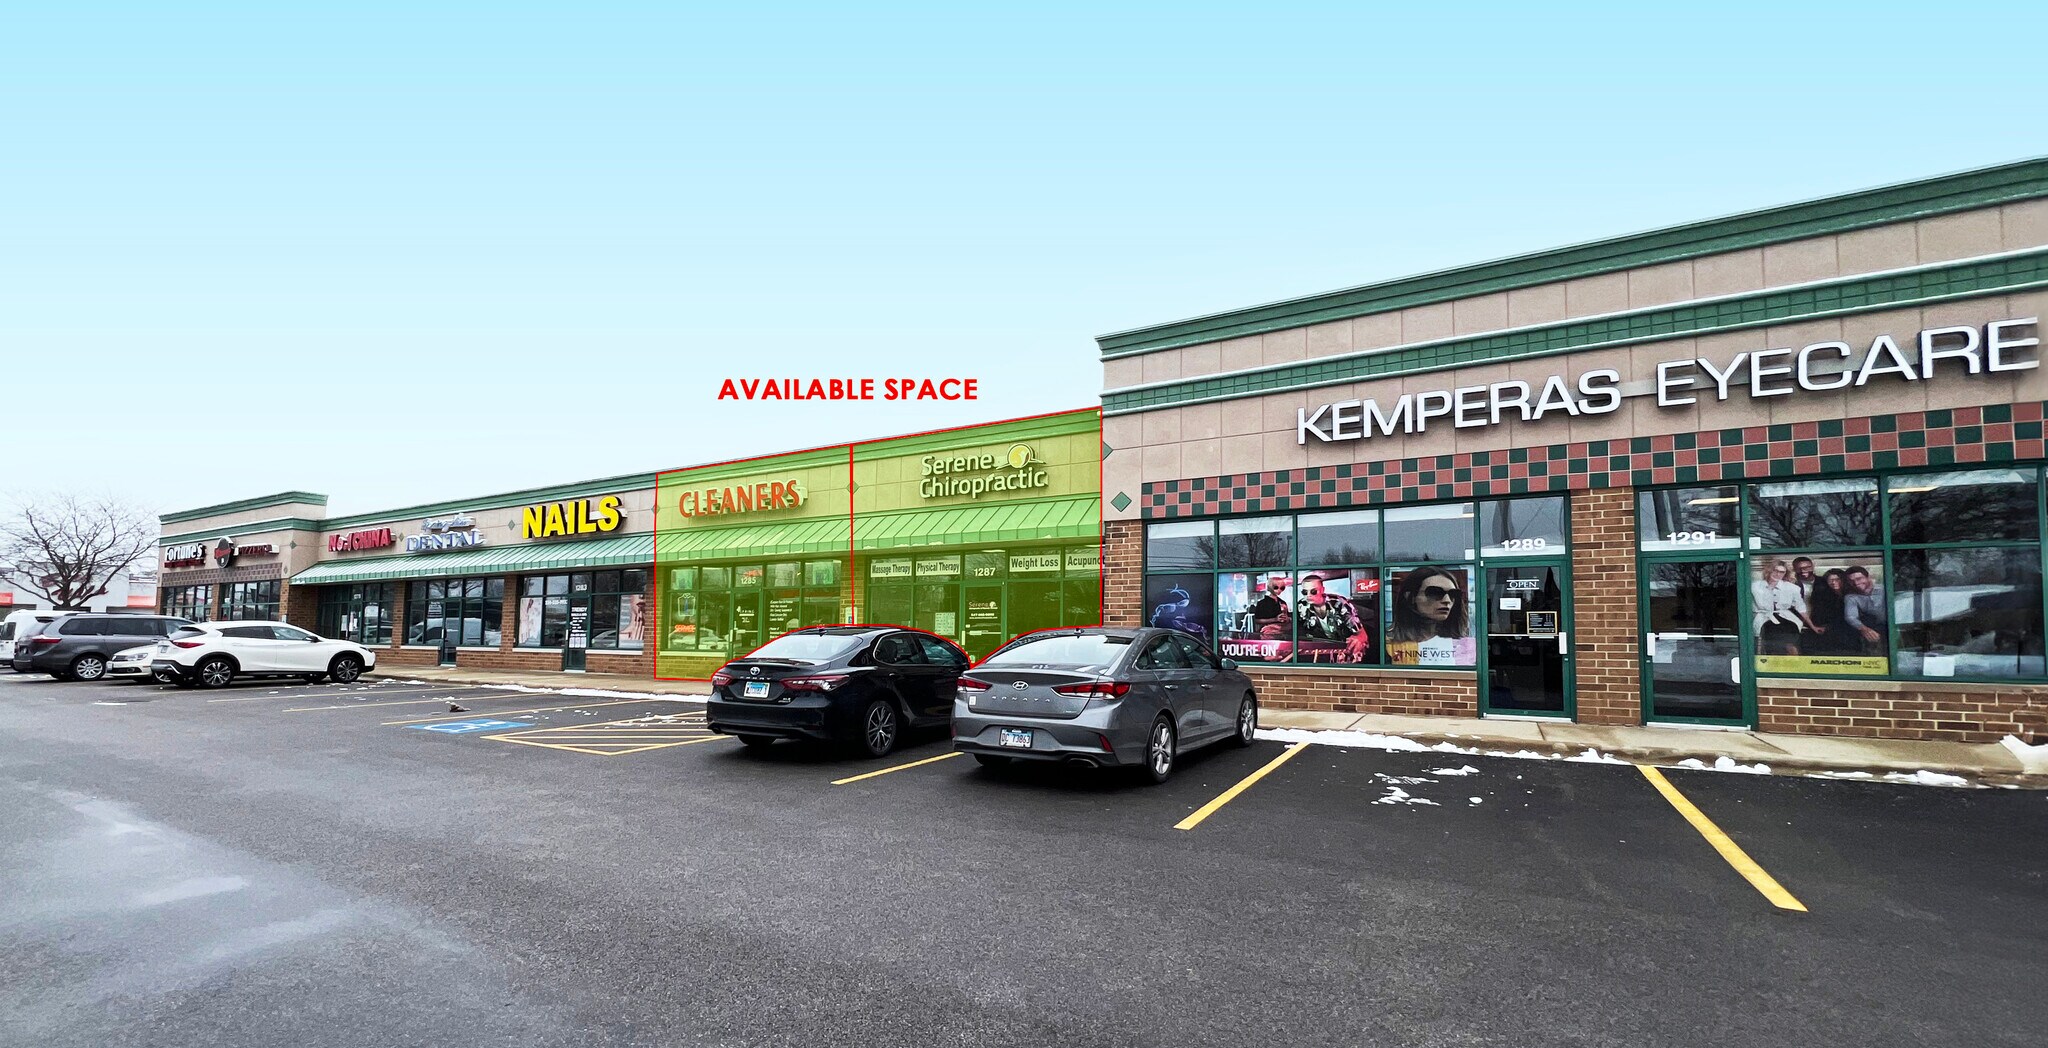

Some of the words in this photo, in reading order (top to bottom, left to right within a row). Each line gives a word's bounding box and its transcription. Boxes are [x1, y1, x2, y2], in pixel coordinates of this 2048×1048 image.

[1296, 368, 1622, 445] KEMPERAS
[1656, 317, 2041, 408] EYECARE
[921, 453, 993, 476] Serene
[919, 467, 1046, 499] Chiropractic
[679, 480, 800, 518] CLEANERS
[522, 495, 620, 539] NAILS
[352, 528, 391, 550] CHINA
[406, 528, 484, 552] DENTAL
[1501, 538, 1546, 551] 1289
[1666, 531, 1716, 545] 1291
[872, 565, 892, 575] Massage
[892, 563, 911, 575] Therapy
[916, 563, 938, 574] Physical
[939, 562, 960, 573] Therapy
[1011, 556, 1038, 570] Weight
[1040, 555, 1059, 567] Loss
[974, 567, 996, 577] 1287
[1221, 643, 1259, 657] YOU'RE
[1260, 644, 1277, 657] ON
[1404, 650, 1428, 658] NINE
[1429, 650, 1457, 658] WEST
